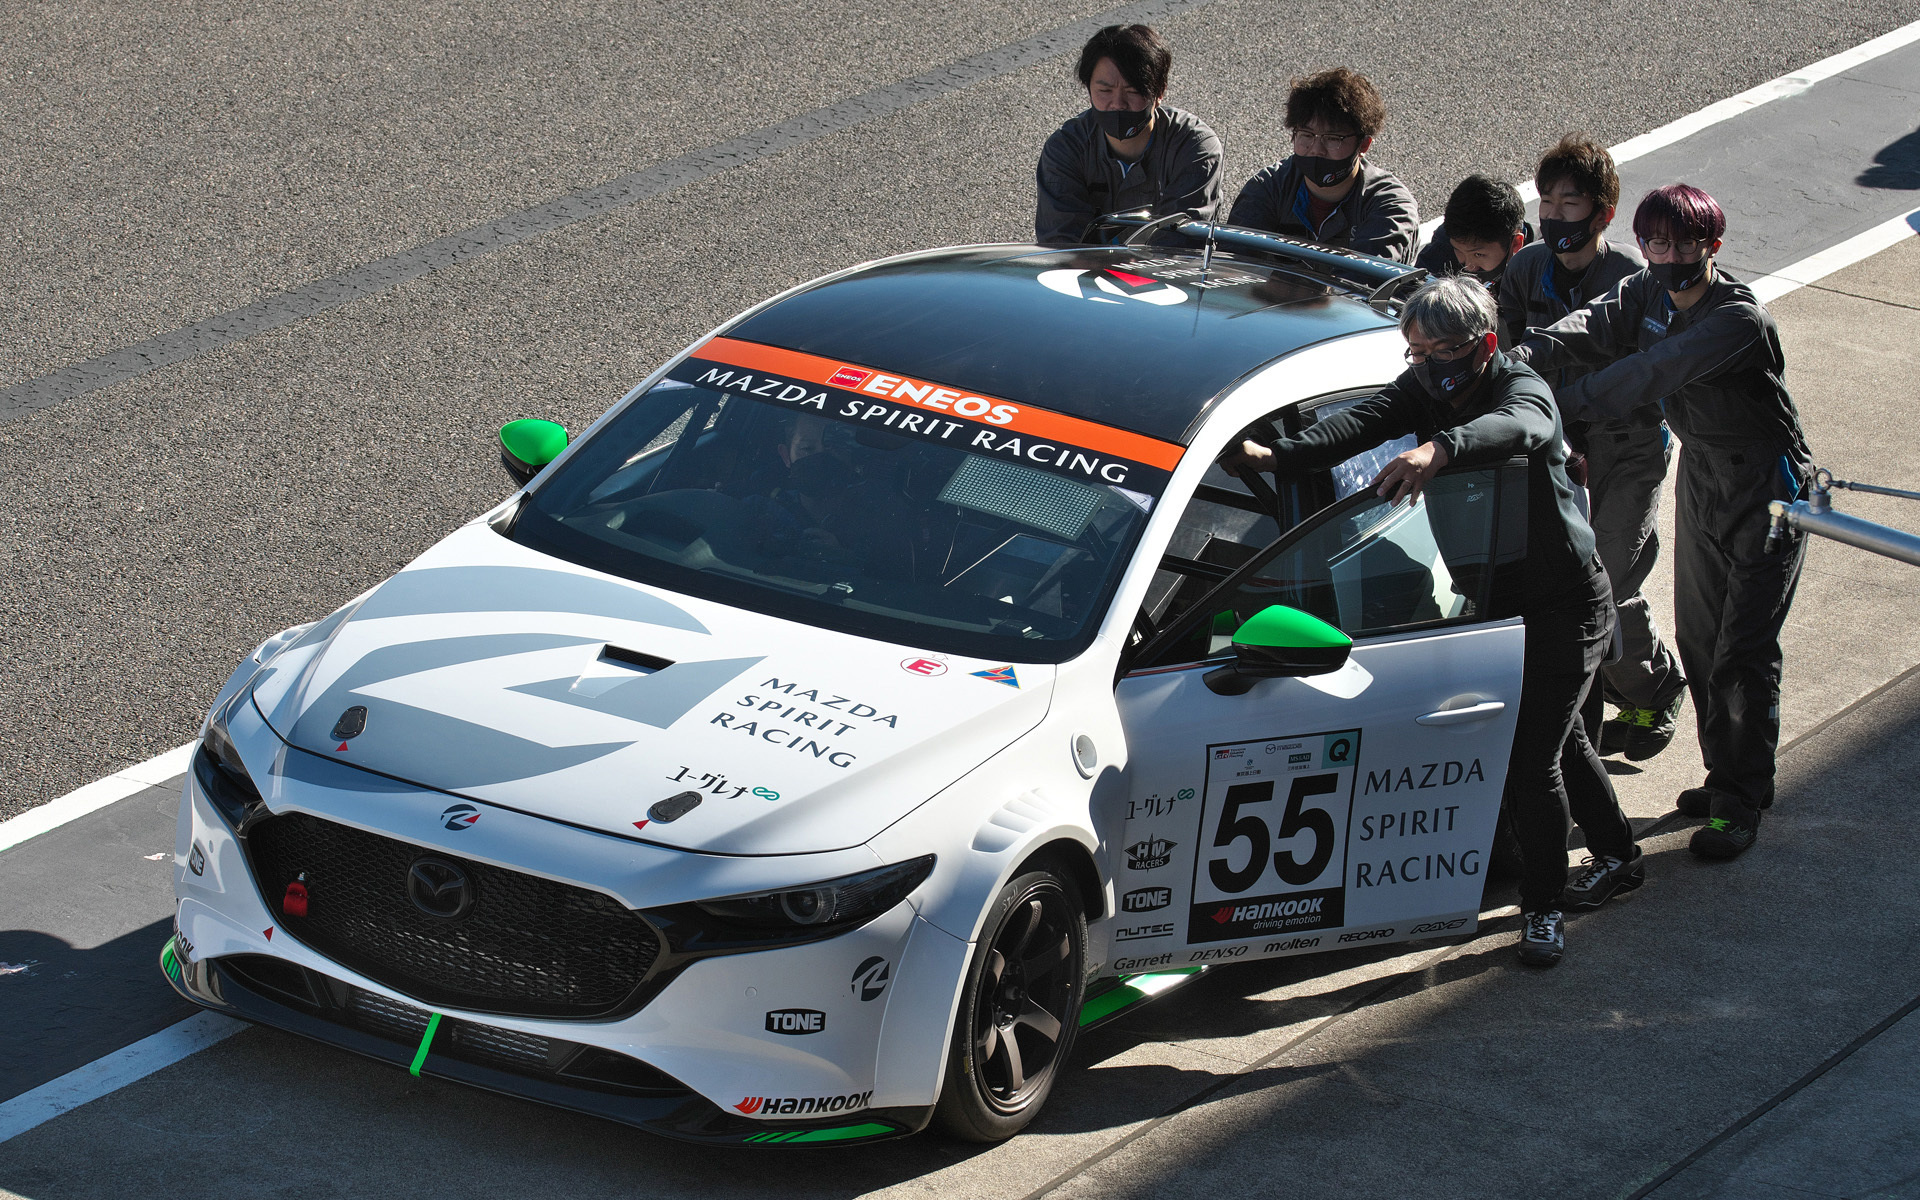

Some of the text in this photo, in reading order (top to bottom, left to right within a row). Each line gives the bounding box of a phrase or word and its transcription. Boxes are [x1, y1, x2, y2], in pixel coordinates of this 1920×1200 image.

[836, 373, 862, 382] ENEOS
[862, 374, 1019, 425] ENEOS
[696, 367, 1130, 484] MAZDA SPIRIT RACING
[736, 694, 856, 737] SPIRIT
[760, 677, 898, 729] MAZDA
[710, 712, 857, 769] RACING
[1329, 738, 1350, 762] Q
[665, 765, 749, 800] ユーグレナ
[1364, 758, 1485, 796] MAZDA
[1125, 794, 1176, 820] ユーグレナ
[1208, 773, 1339, 894] 55
[1360, 806, 1460, 841] SPIRIT
[1135, 858, 1164, 869] RACERS
[1356, 850, 1480, 889] RACING
[1126, 890, 1169, 910] TONE
[1253, 915, 1321, 930] driving emotion
[1264, 938, 1321, 952] molten
[1338, 928, 1395, 944] RECARO
[1114, 953, 1173, 970] Garrett
[1189, 945, 1248, 962] DENSO
[769, 1013, 822, 1030] TONE
